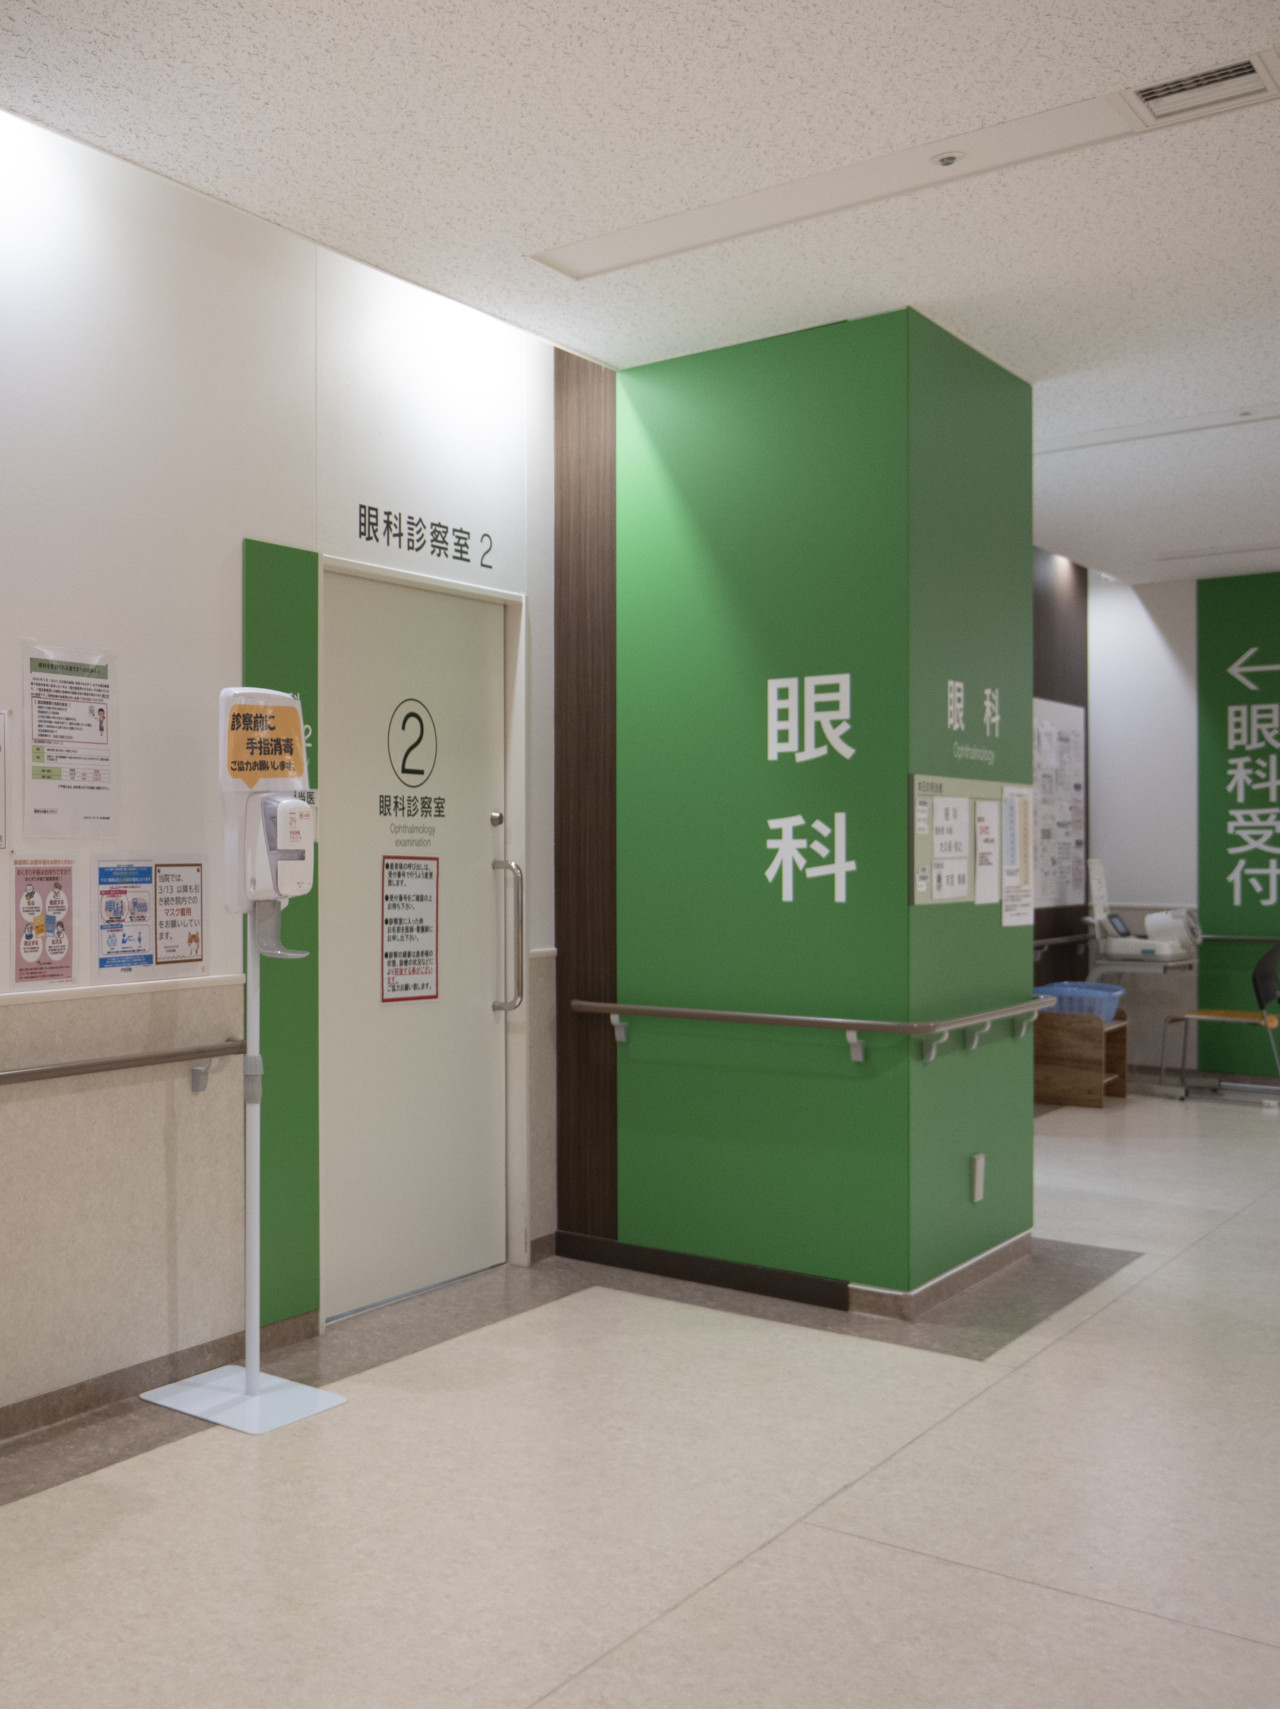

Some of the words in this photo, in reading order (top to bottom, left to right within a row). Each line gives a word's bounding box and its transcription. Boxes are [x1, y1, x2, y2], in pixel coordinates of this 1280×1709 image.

[358, 503, 471, 563] 眼科診察室
[479, 533, 493, 569] 2
[947, 679, 1000, 738] 眼科
[230, 712, 276, 731] 診察前に
[245, 738, 294, 756] 手指消毒
[764, 673, 857, 902] 眼科
[379, 794, 446, 818] 眼科診察室
[1225, 703, 1280, 907] 眼科受付
[389, 822, 436, 836] Ophthalmology
[395, 836, 432, 847] examination
[158, 885, 174, 894] 3/13
[164, 908, 192, 917] マスク着用
